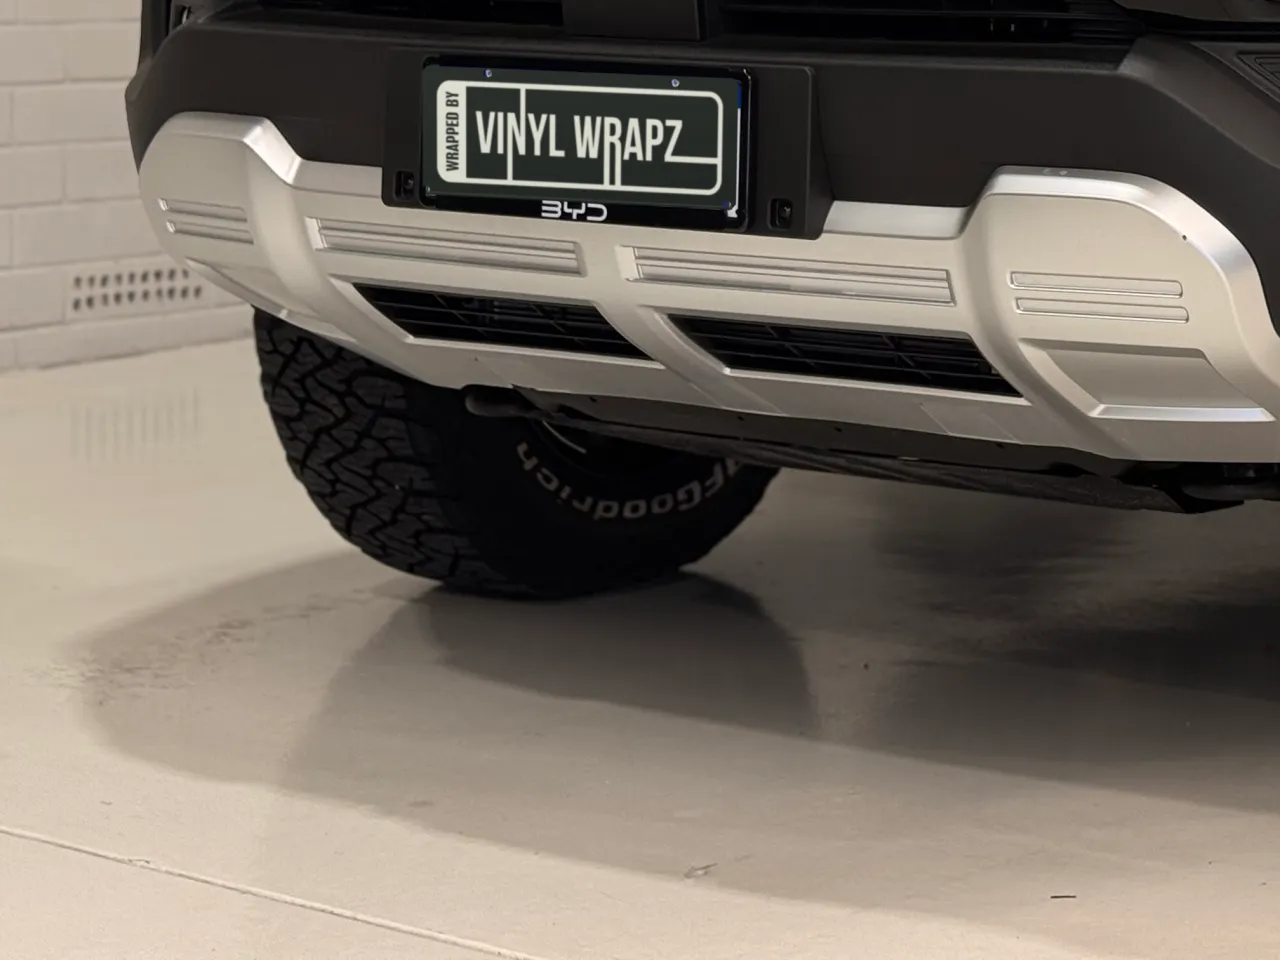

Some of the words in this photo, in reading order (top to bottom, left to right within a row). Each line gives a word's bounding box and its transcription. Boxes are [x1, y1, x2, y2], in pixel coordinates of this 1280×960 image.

[445, 91, 460, 108] BY
[445, 111, 460, 172] WRAPPED
[475, 111, 565, 157] VINYL
[573, 115, 683, 162] WRAPZ
[541, 200, 608, 221] BYD
